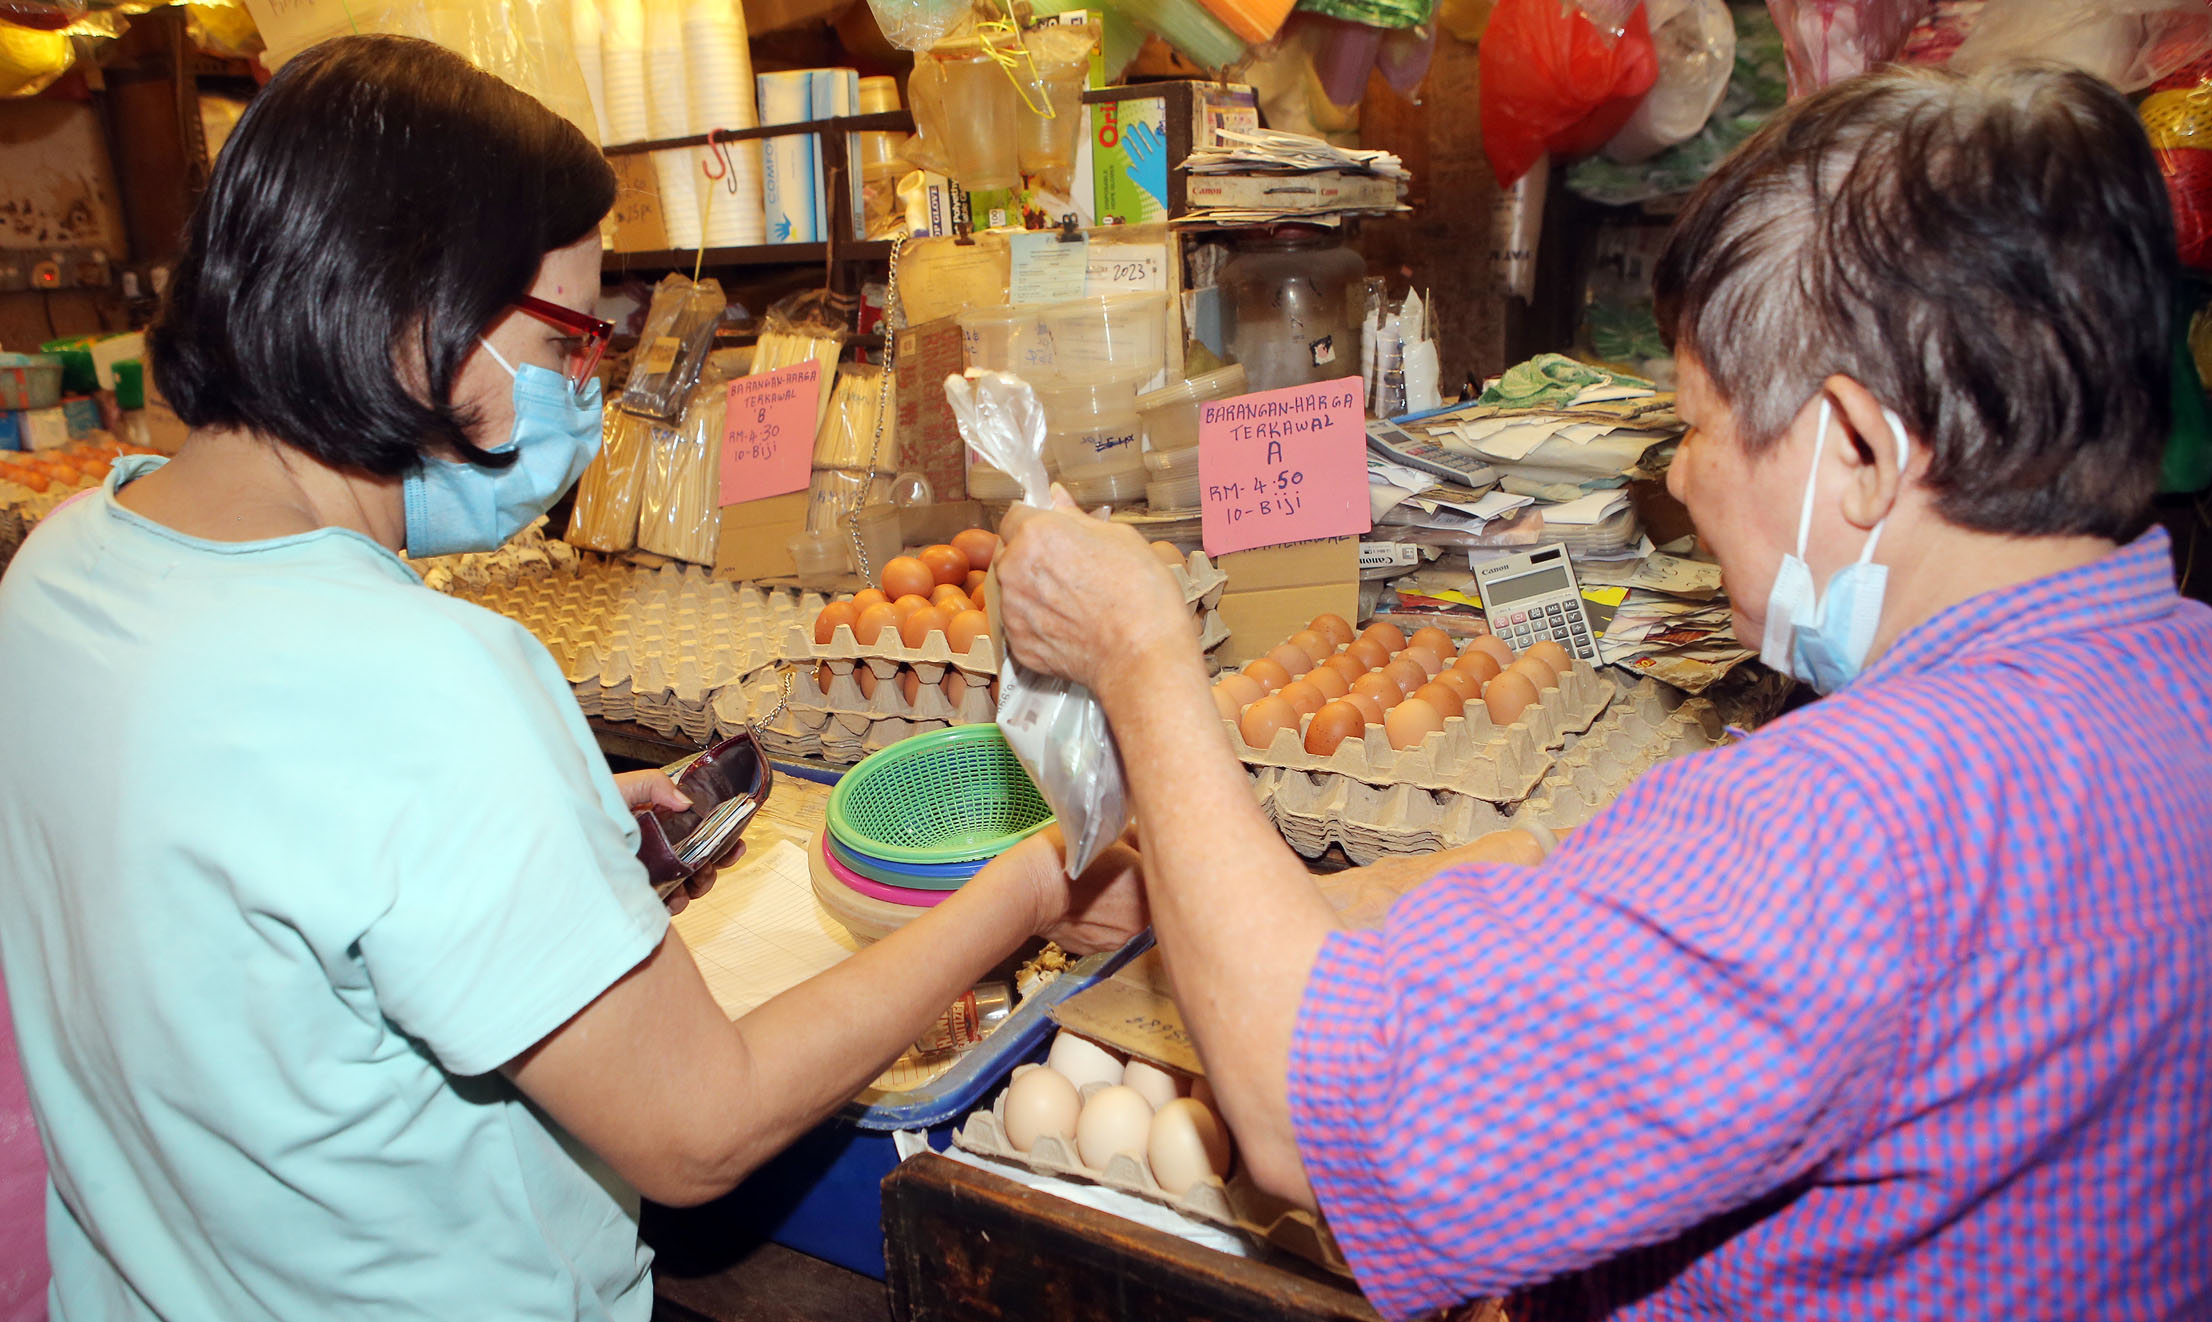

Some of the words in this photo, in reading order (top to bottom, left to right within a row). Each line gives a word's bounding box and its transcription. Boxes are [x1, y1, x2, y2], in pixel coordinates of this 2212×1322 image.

[765, 138, 777, 204] COMFO
[1192, 185, 1222, 195] Canon
[931, 186, 941, 224] GLOVE
[1113, 263, 1145, 281] 2023
[731, 370, 817, 397] BARANGAN-HARGA
[744, 389, 796, 408] TERKAWAL
[1206, 393, 1354, 424] BARANGAN-HARGA
[1230, 415, 1334, 441] TERKAWAL
[1267, 441, 1282, 465] A
[1359, 556, 1394, 566] Canon
[1481, 564, 1509, 576] Canon
